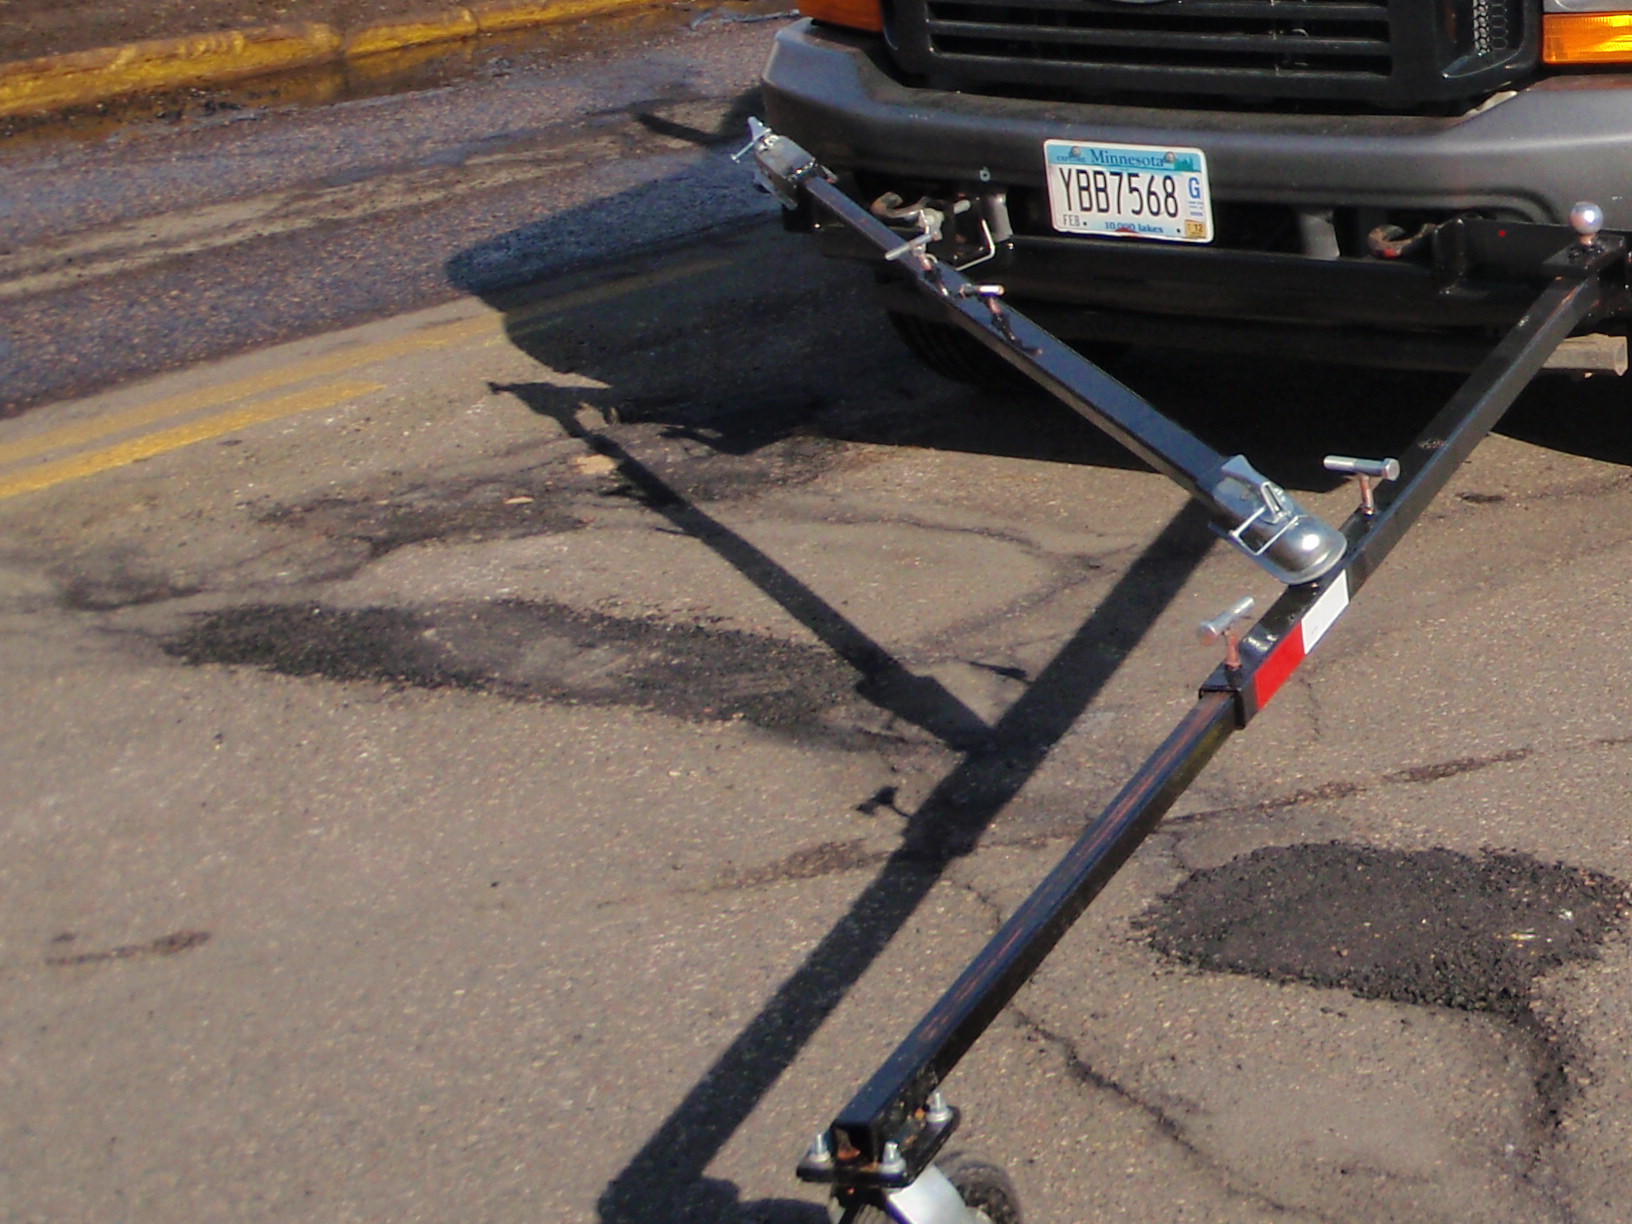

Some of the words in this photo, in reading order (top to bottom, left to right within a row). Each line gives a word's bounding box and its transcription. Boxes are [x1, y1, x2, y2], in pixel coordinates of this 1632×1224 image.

[1090, 149, 1165, 168] Minnesota
[1058, 167, 1179, 218] YBB7568
[1188, 176, 1201, 199] G
[1063, 214, 1080, 227] FEB
[1105, 221, 1136, 232] 10000
[1138, 223, 1164, 234] lakes
